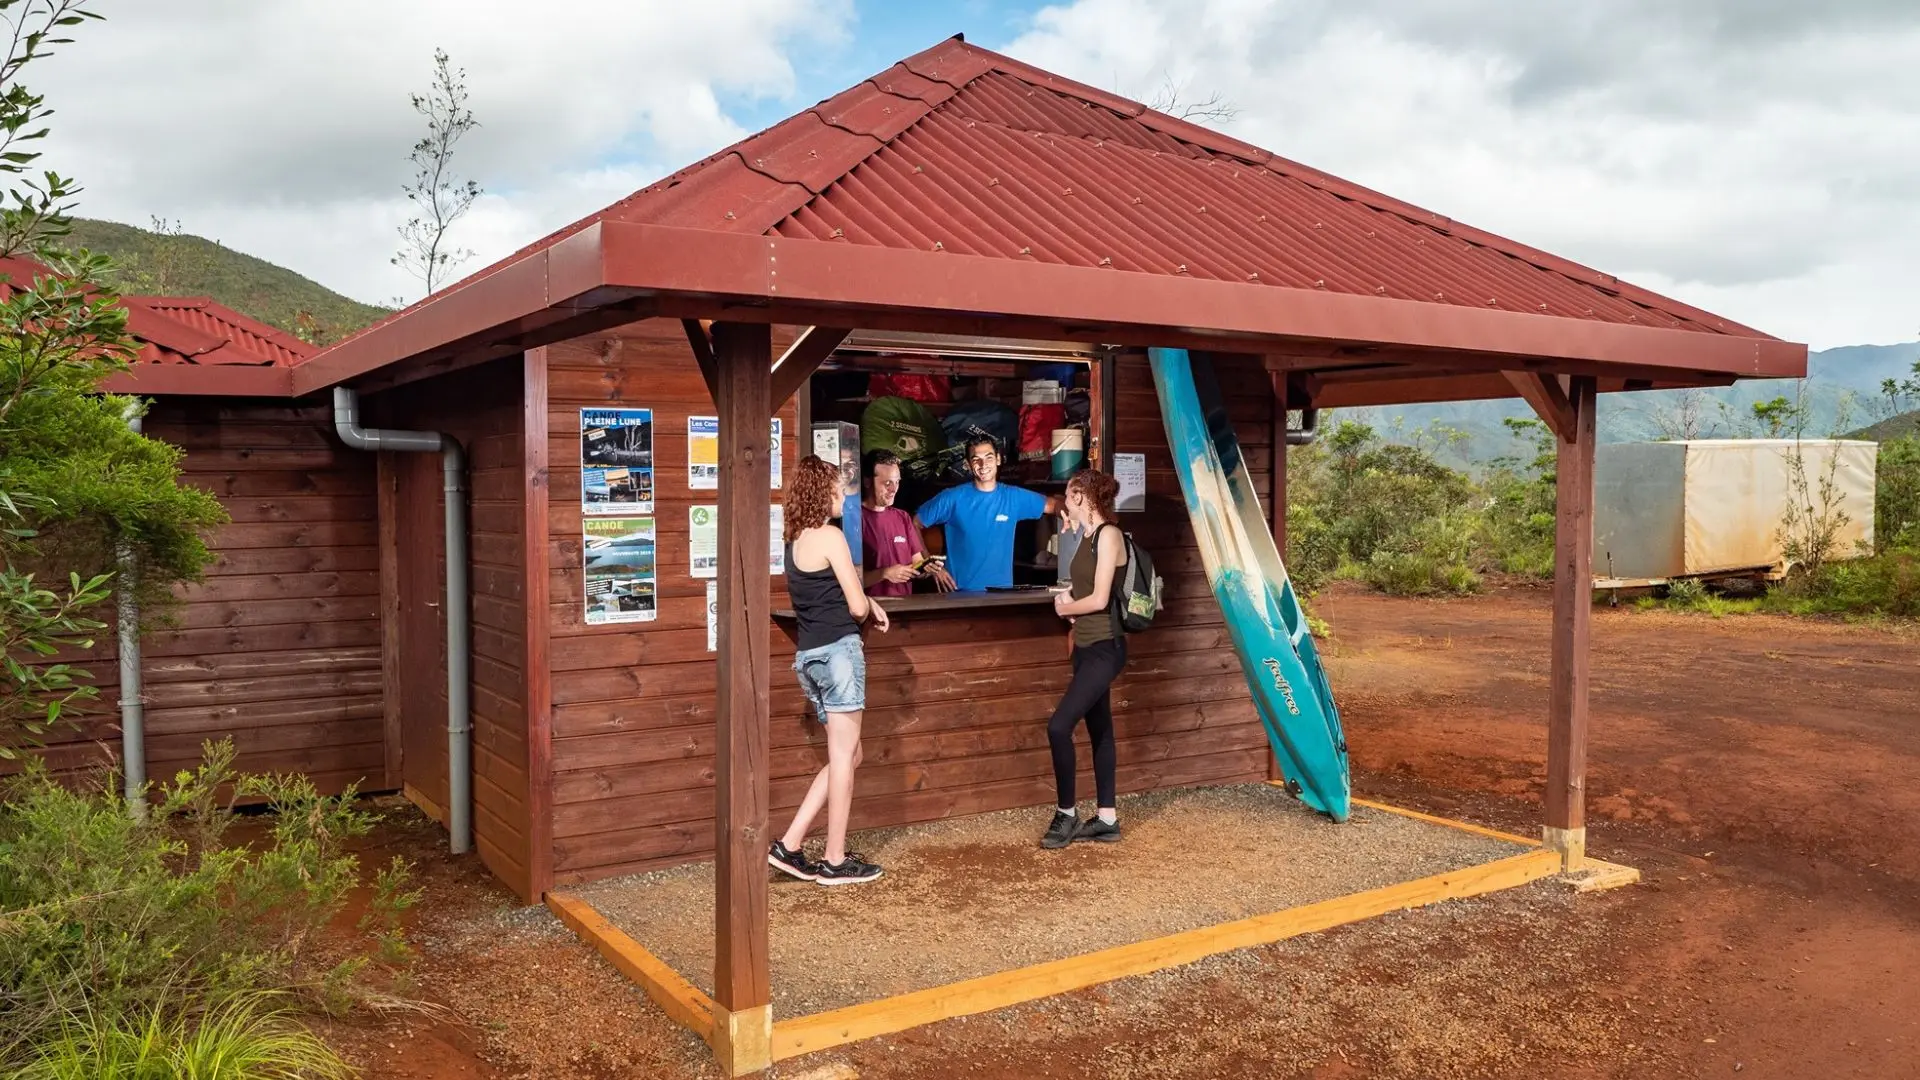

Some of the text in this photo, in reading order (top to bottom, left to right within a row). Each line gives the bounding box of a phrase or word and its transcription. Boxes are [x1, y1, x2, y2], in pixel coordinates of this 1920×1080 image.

[584, 417, 617, 426] PLEINE
[586, 520, 624, 530] CANOE
[1263, 658, 1300, 715] feelfree
